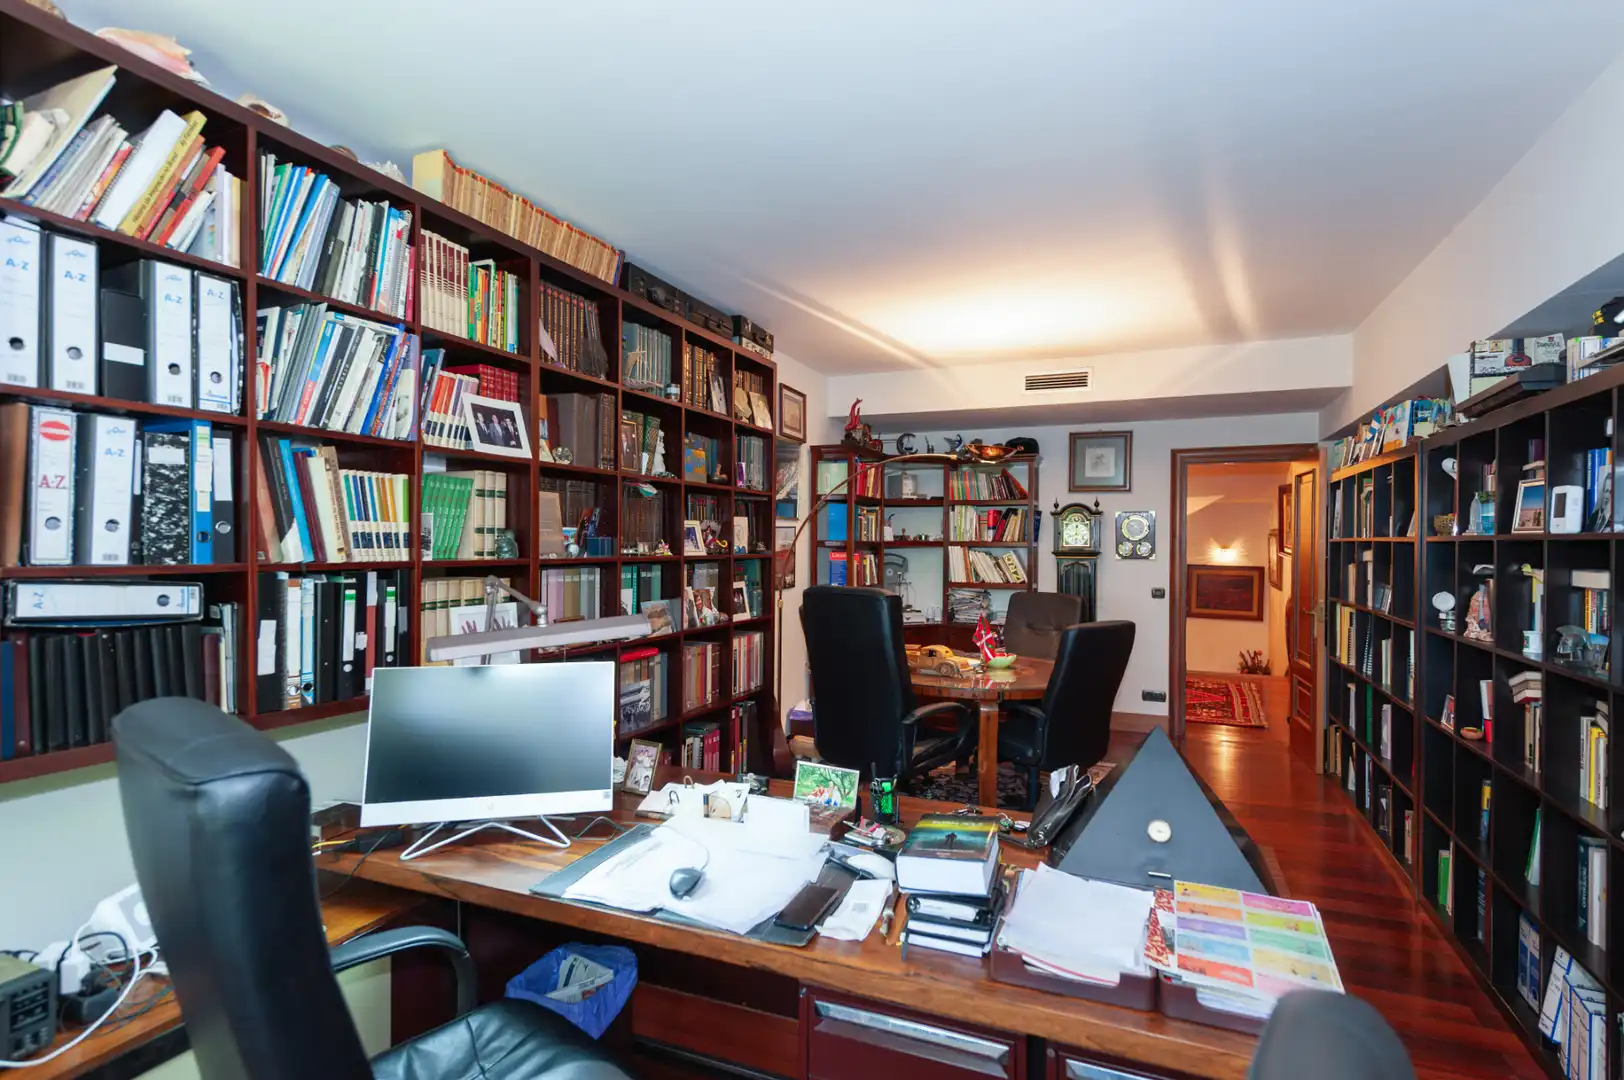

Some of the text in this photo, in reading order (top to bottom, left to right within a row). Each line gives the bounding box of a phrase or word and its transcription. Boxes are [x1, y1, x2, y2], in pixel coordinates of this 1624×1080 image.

[5, 258, 29, 270] A-Z
[64, 270, 86, 282] A-Z
[164, 293, 182, 304] A-Z
[104, 447, 125, 457] A-Z
[38, 474, 68, 489] A-Z
